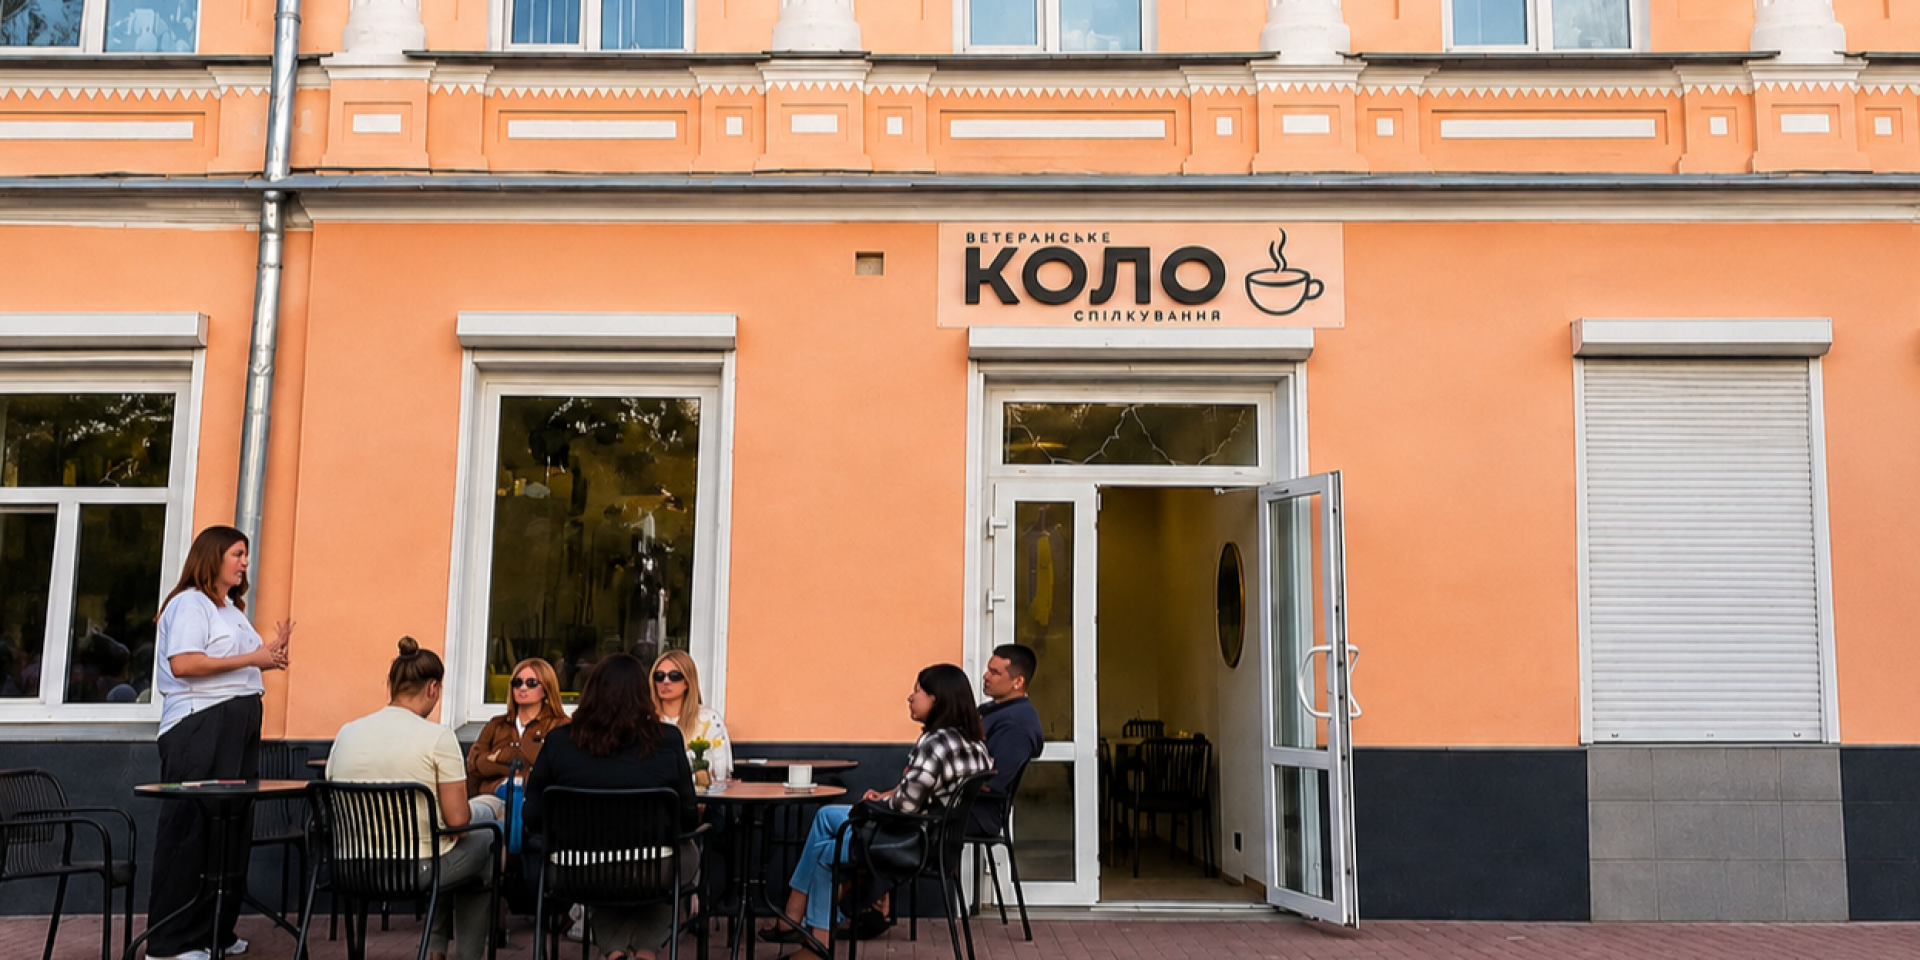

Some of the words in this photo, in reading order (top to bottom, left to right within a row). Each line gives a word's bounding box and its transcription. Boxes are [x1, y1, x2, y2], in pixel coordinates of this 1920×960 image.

[966, 232, 1112, 244] ВЕТЕРАНСЬКЕ
[965, 246, 1226, 305] КОЛО
[1073, 310, 1222, 322] СПІЛКУВАННЯ
